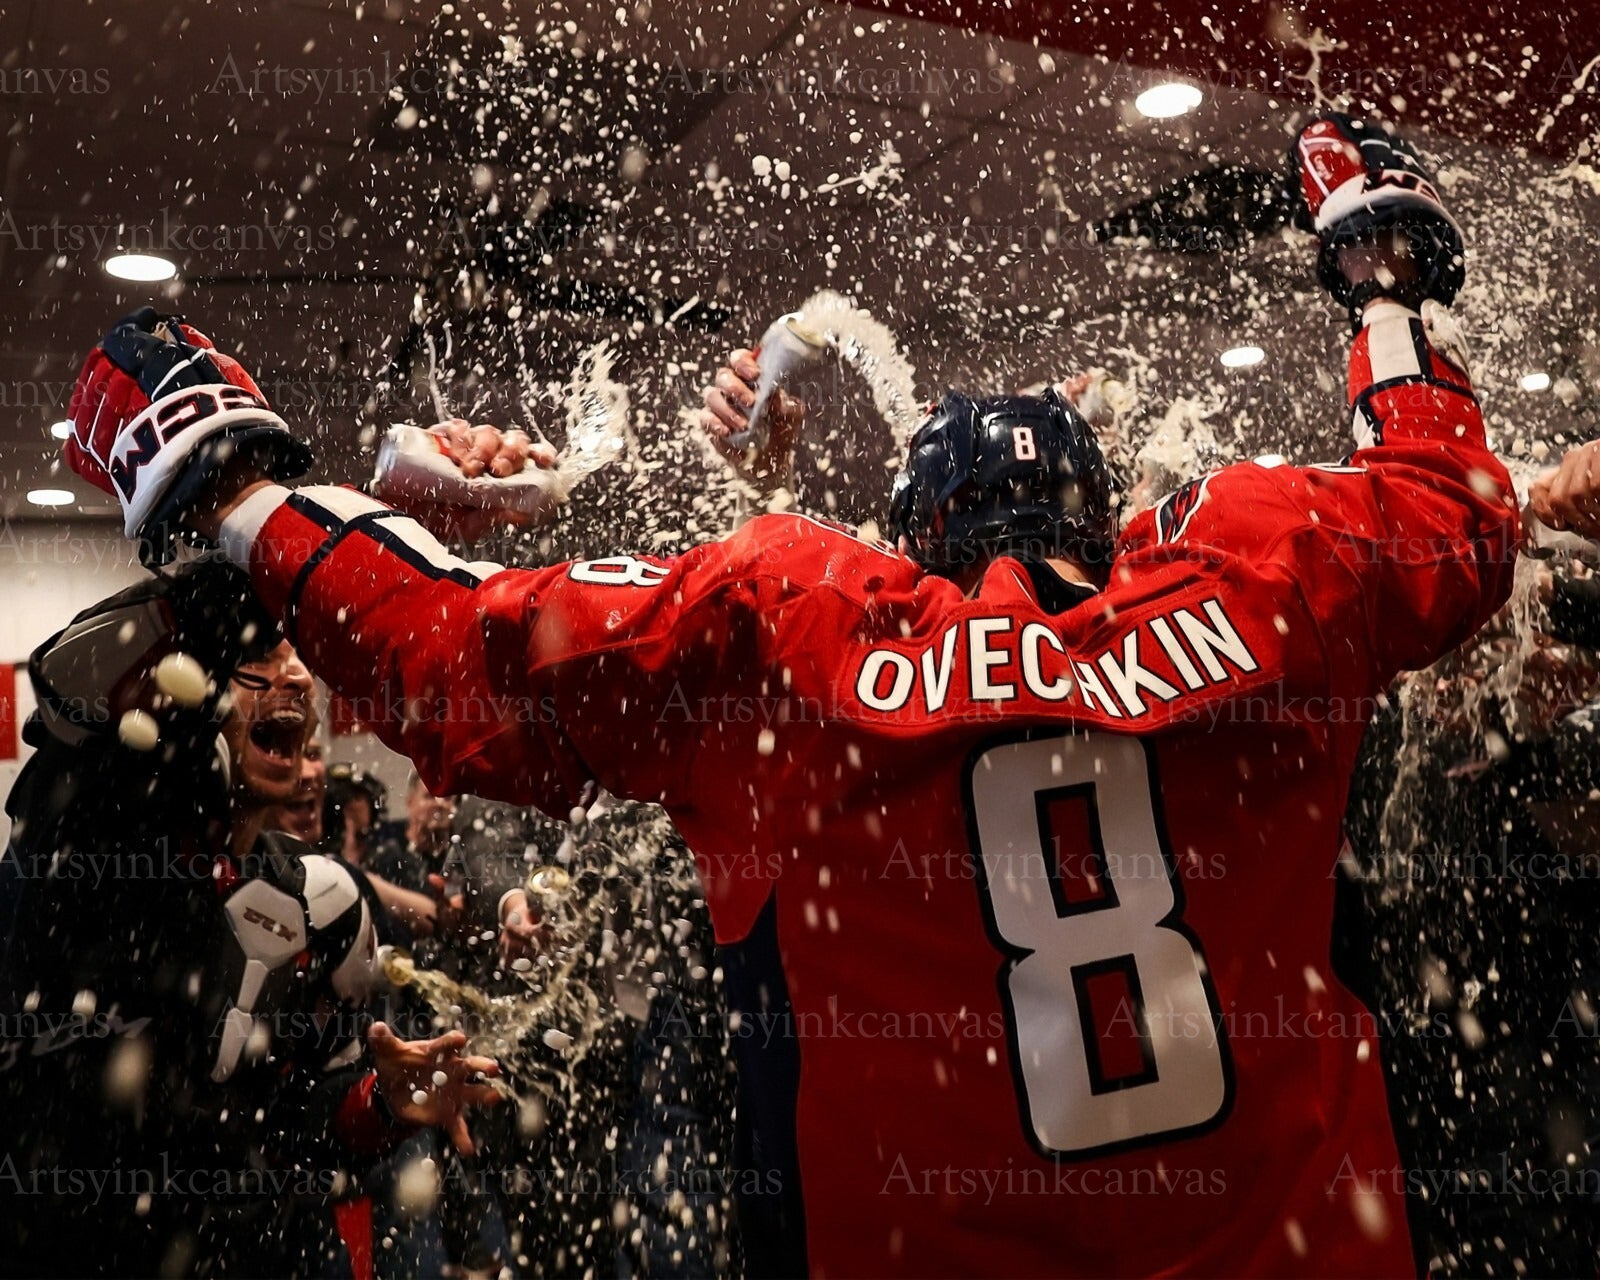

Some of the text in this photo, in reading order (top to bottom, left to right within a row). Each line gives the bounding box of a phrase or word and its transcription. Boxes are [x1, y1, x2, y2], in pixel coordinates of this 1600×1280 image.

[1011, 426, 1037, 461] 8
[855, 598, 1261, 719] OVECHKIN
[963, 729, 1234, 1160] 8
